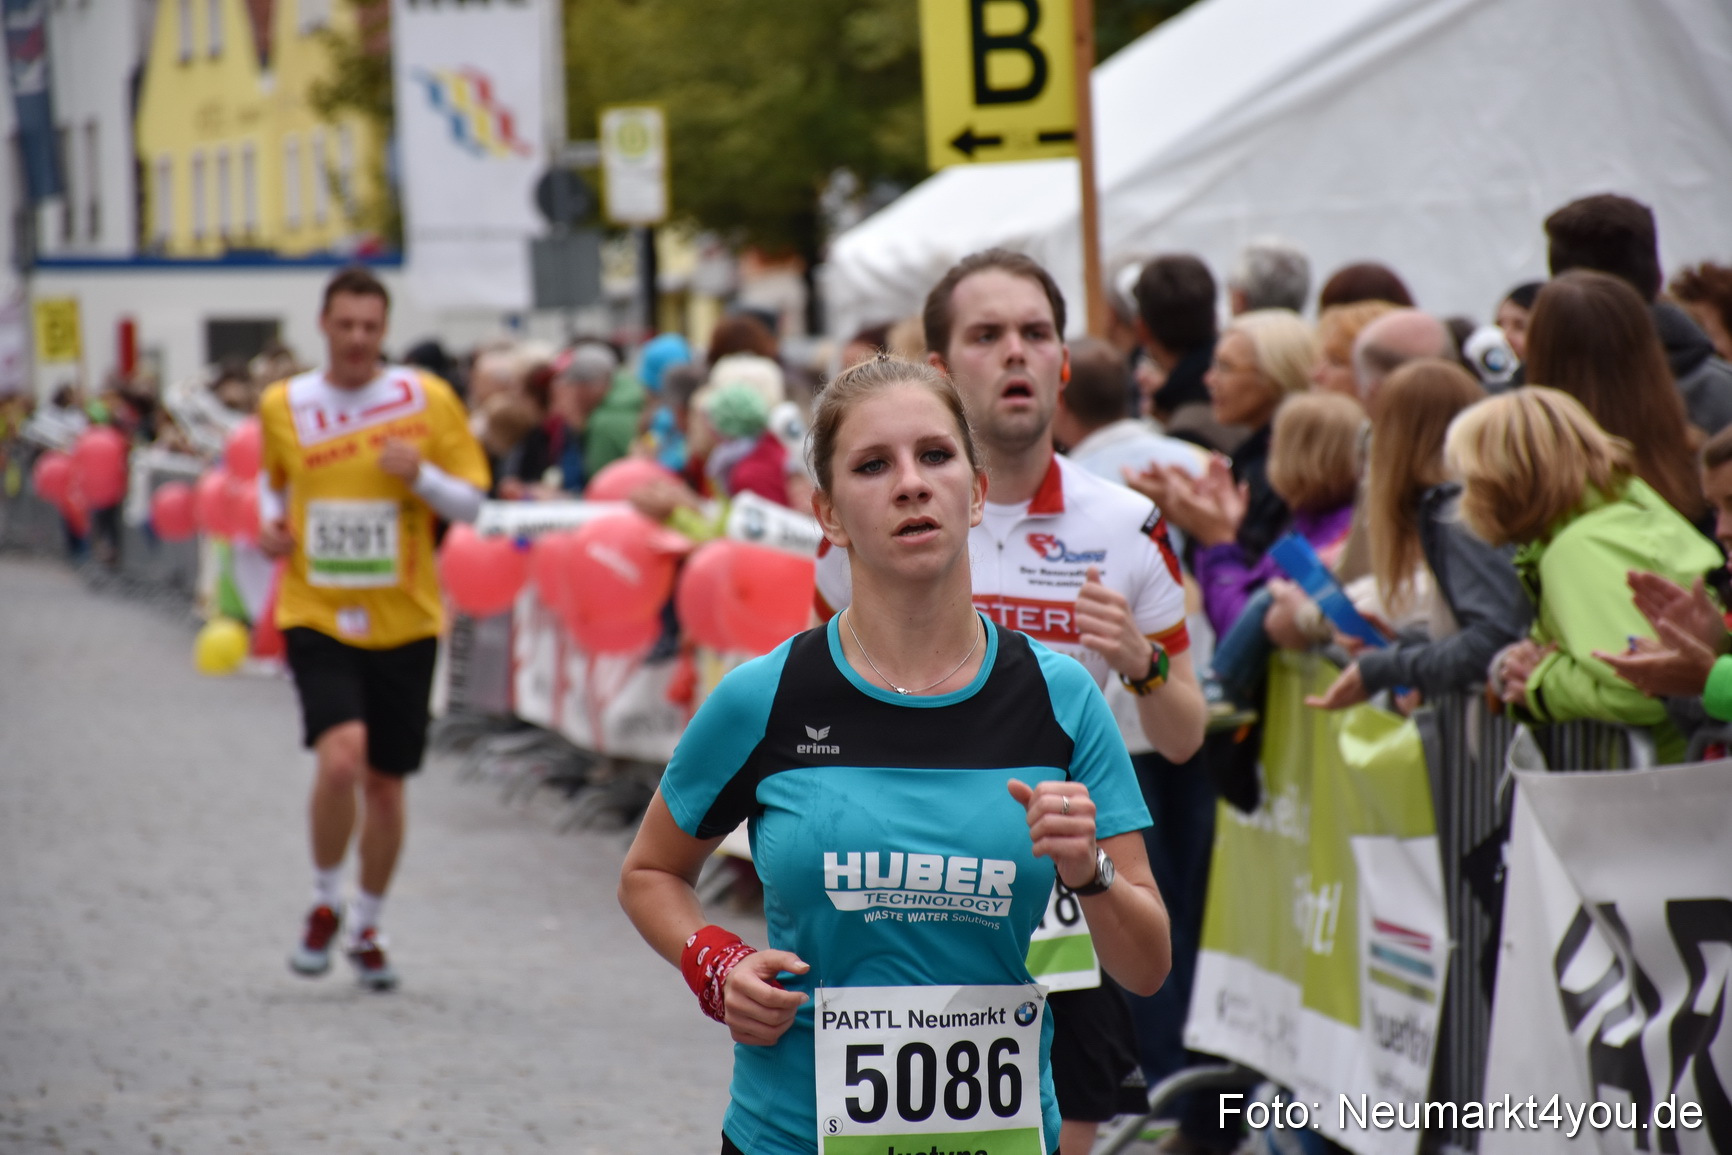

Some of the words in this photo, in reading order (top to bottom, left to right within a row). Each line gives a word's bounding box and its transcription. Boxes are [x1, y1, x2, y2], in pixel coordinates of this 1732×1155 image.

[969, 0, 1049, 106] B
[796, 743, 840, 755] erima
[823, 851, 1017, 897] HUBER
[864, 892, 1004, 913] TECHNOLOGY
[864, 910, 903, 924] WASTE
[907, 912, 949, 924] WATER
[951, 912, 1001, 931] Solutions
[822, 1010, 902, 1030] PARTL
[908, 1006, 1007, 1029] Neumarkt
[844, 1037, 1023, 1124] 5086
[828, 1119, 838, 1133] S
